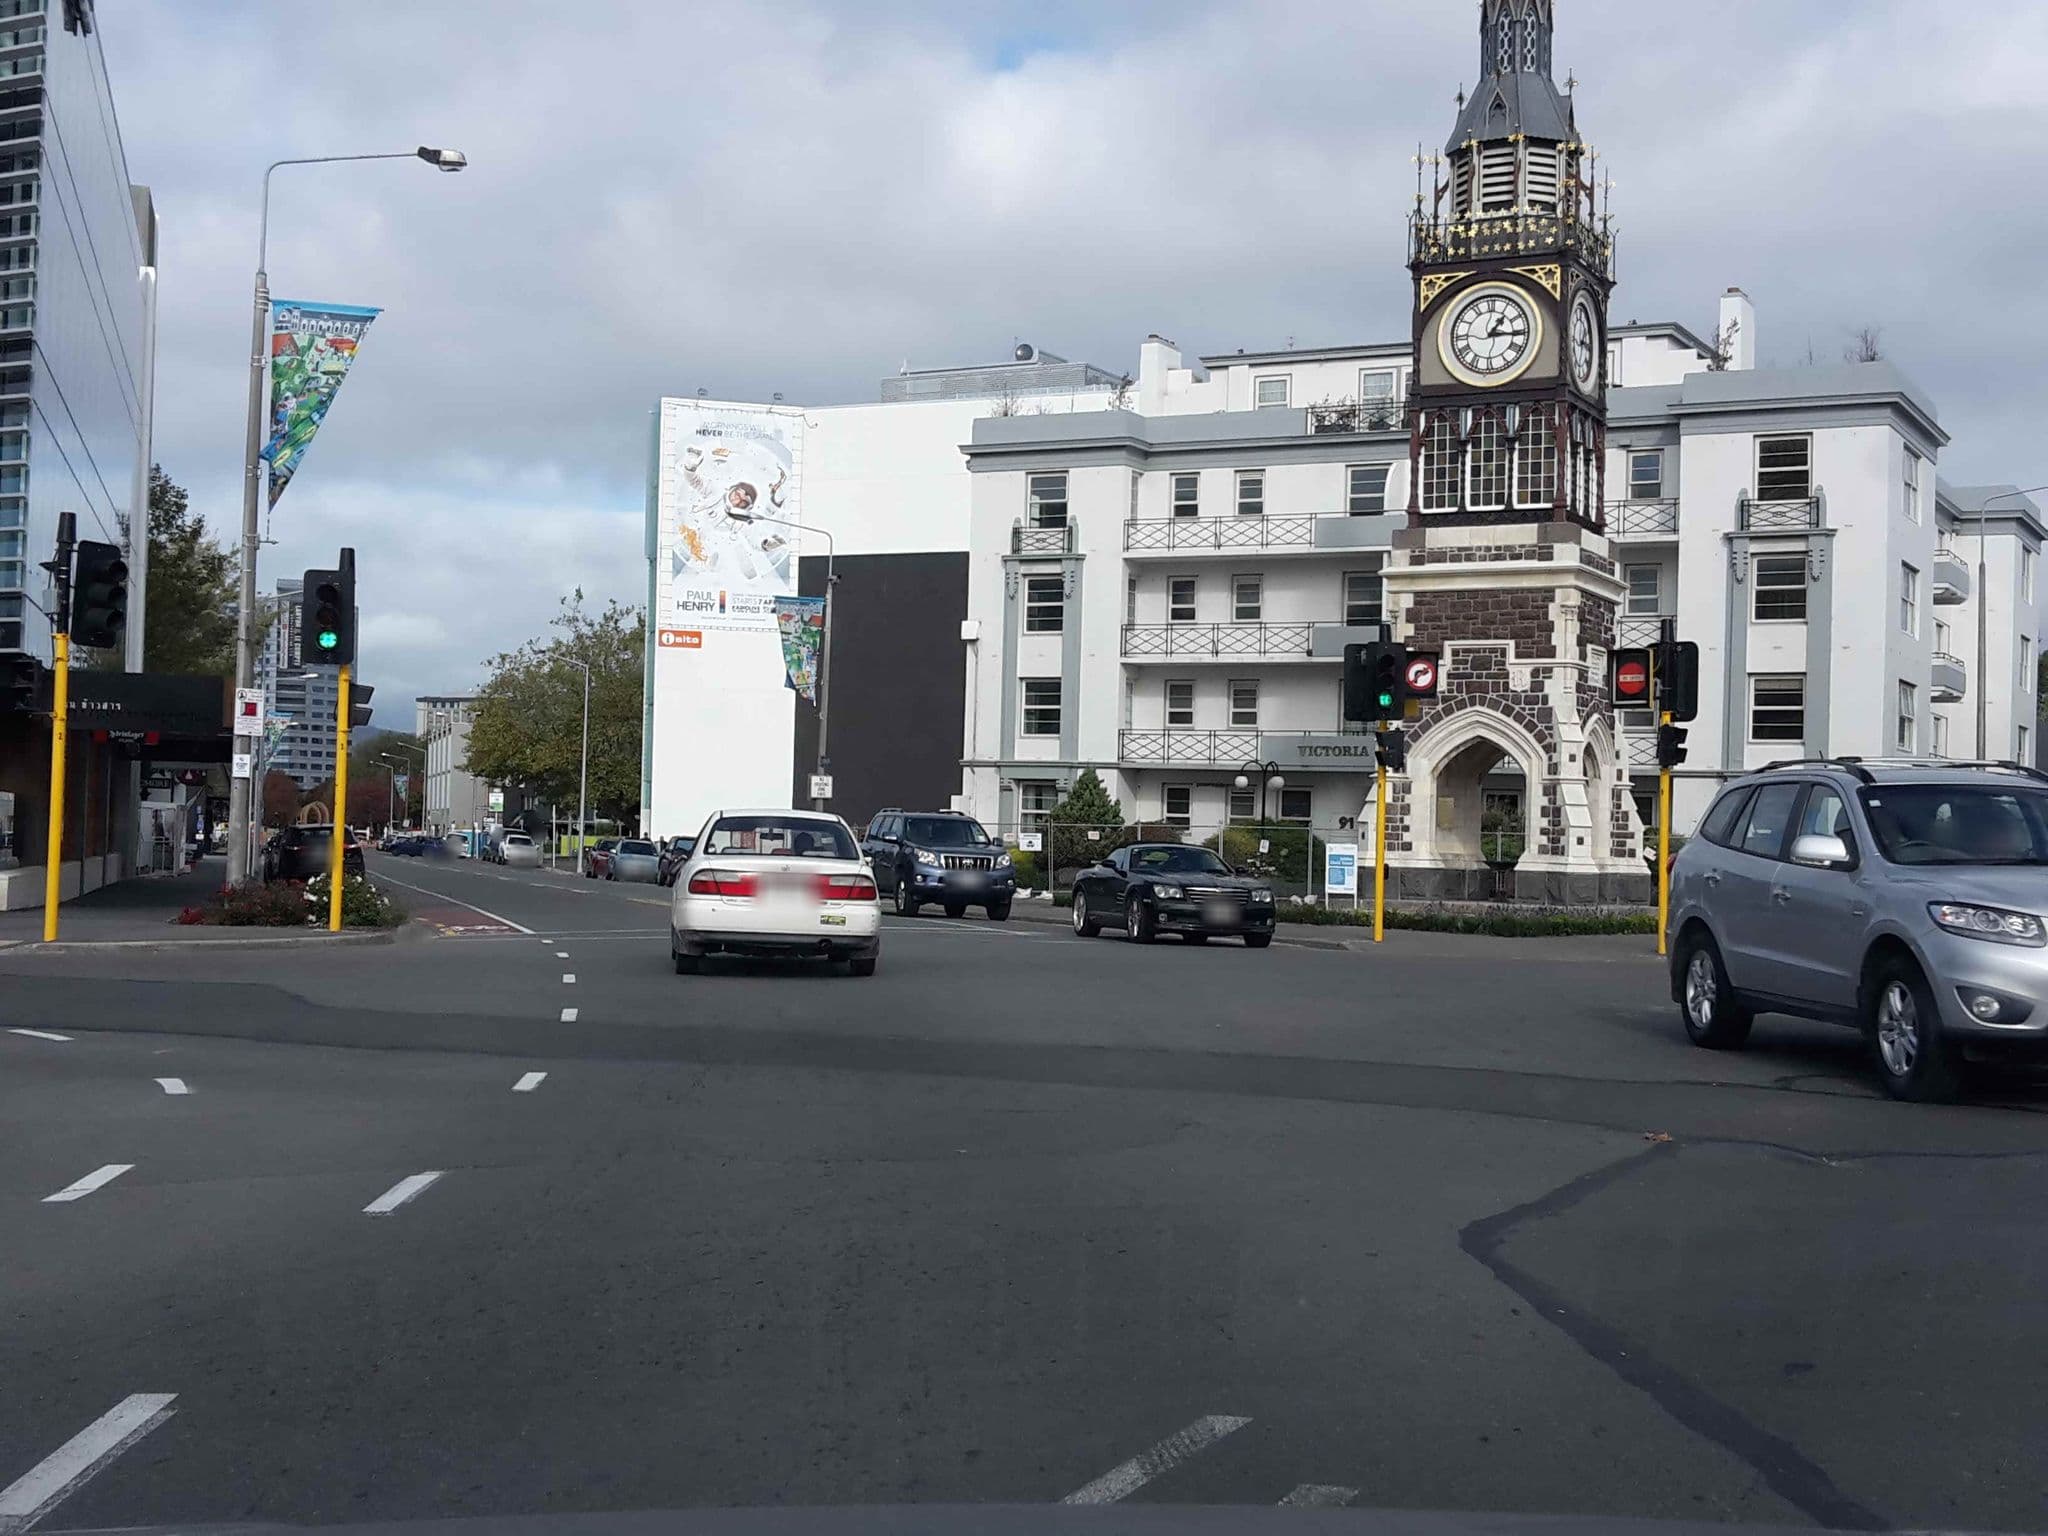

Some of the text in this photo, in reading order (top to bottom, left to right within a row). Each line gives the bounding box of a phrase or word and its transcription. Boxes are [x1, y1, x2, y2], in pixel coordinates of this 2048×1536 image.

[696, 428, 723, 437] NEVER
[686, 590, 716, 601] PAUL
[676, 601, 716, 612] HENRY
[1297, 746, 1370, 757] VICTORIA
[1338, 816, 1354, 830] 91
